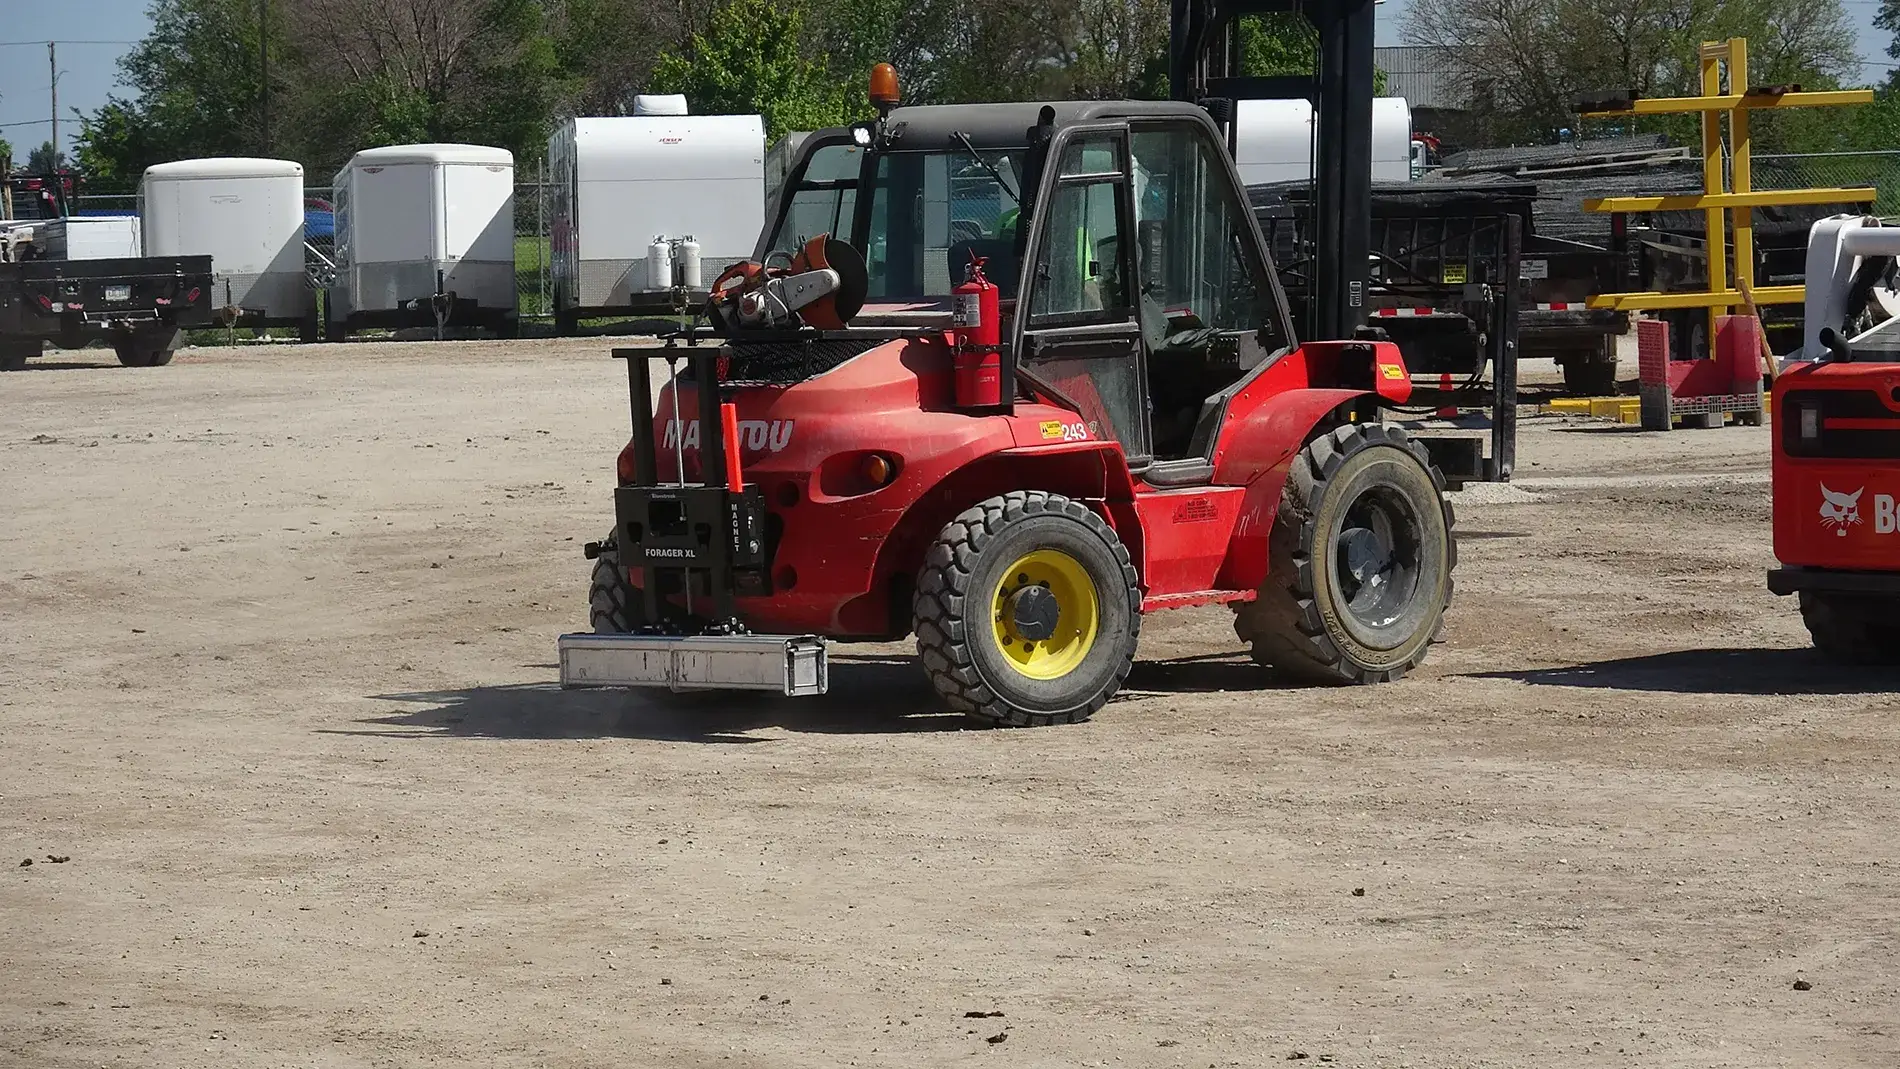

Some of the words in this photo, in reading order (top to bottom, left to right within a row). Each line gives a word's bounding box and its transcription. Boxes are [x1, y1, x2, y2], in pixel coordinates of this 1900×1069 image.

[662, 419, 794, 452] MATOU
[1061, 423, 1087, 440] 243
[731, 503, 740, 552] MAGNET
[1874, 494, 1900, 534] B
[645, 548, 684, 557] FORAGER
[685, 549, 696, 558] XL
